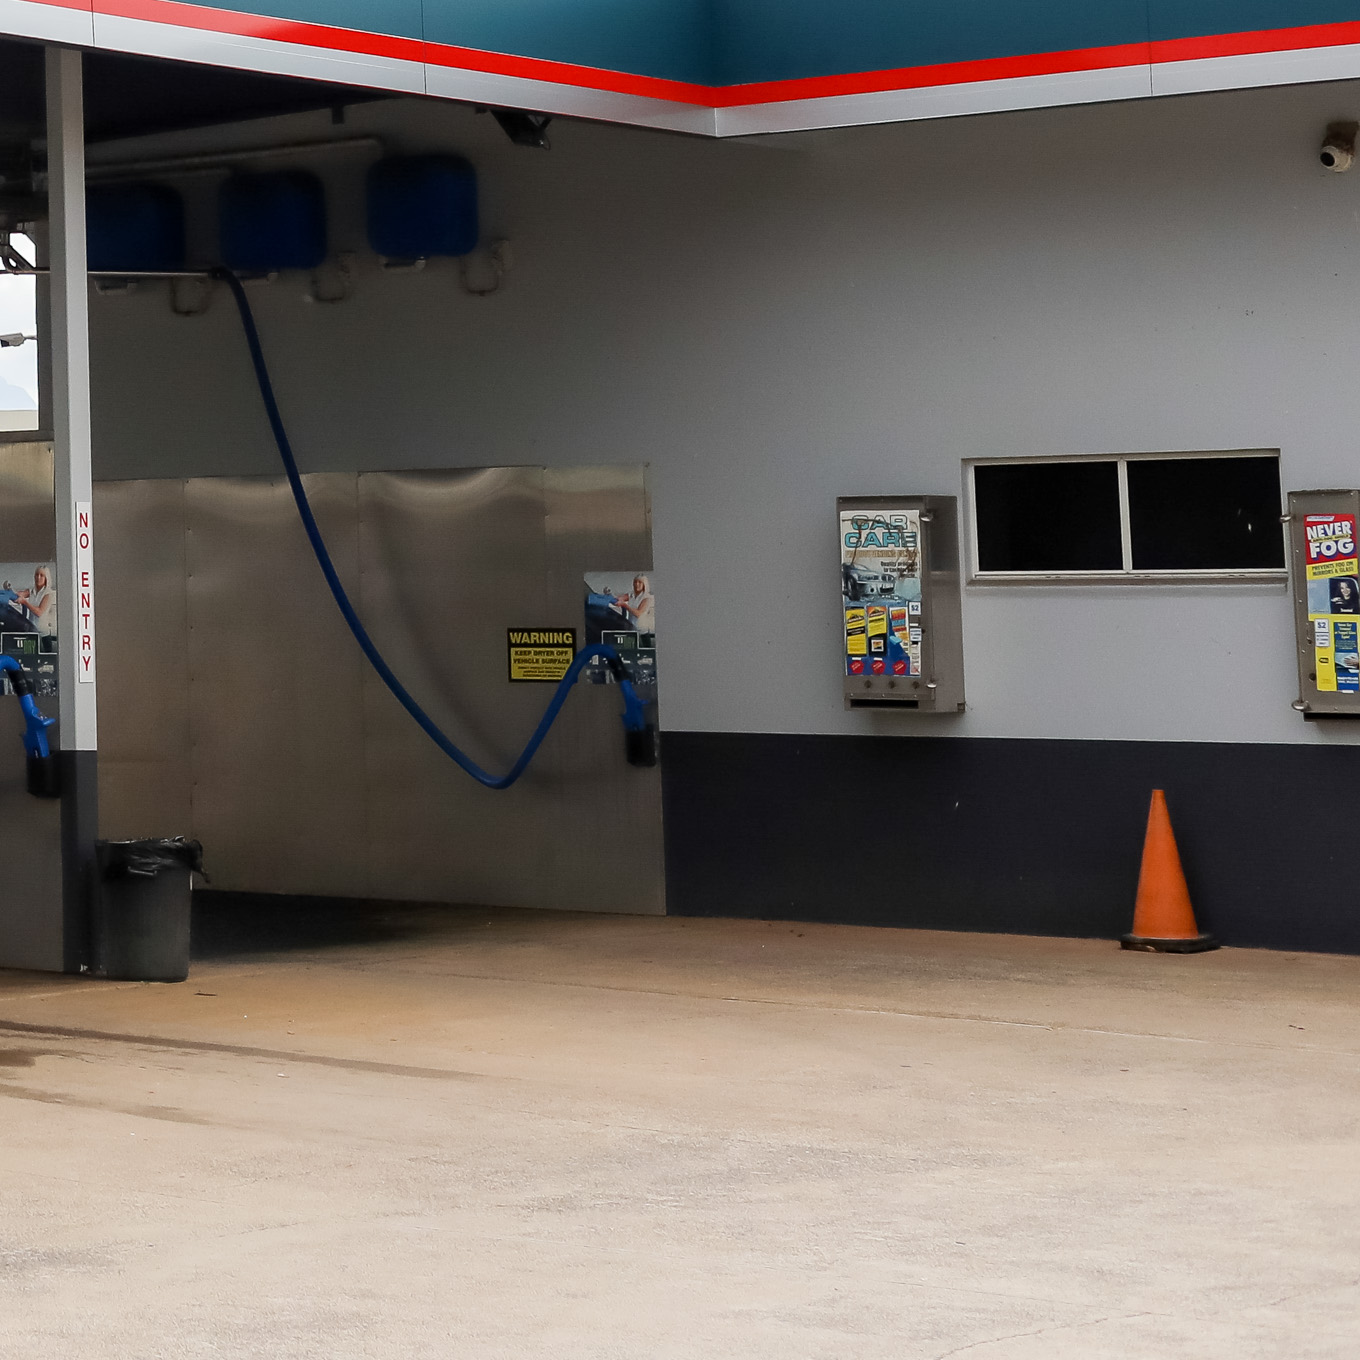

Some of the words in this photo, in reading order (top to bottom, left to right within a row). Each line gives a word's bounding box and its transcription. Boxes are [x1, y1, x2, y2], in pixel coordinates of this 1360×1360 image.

[79, 512, 89, 549] NO
[851, 514, 908, 531] CAR
[1306, 521, 1352, 540] NEVER
[844, 531, 918, 548] CARE
[1309, 538, 1354, 558] FOG
[82, 571, 91, 672] ENTRY
[509, 632, 573, 644] WARNING
